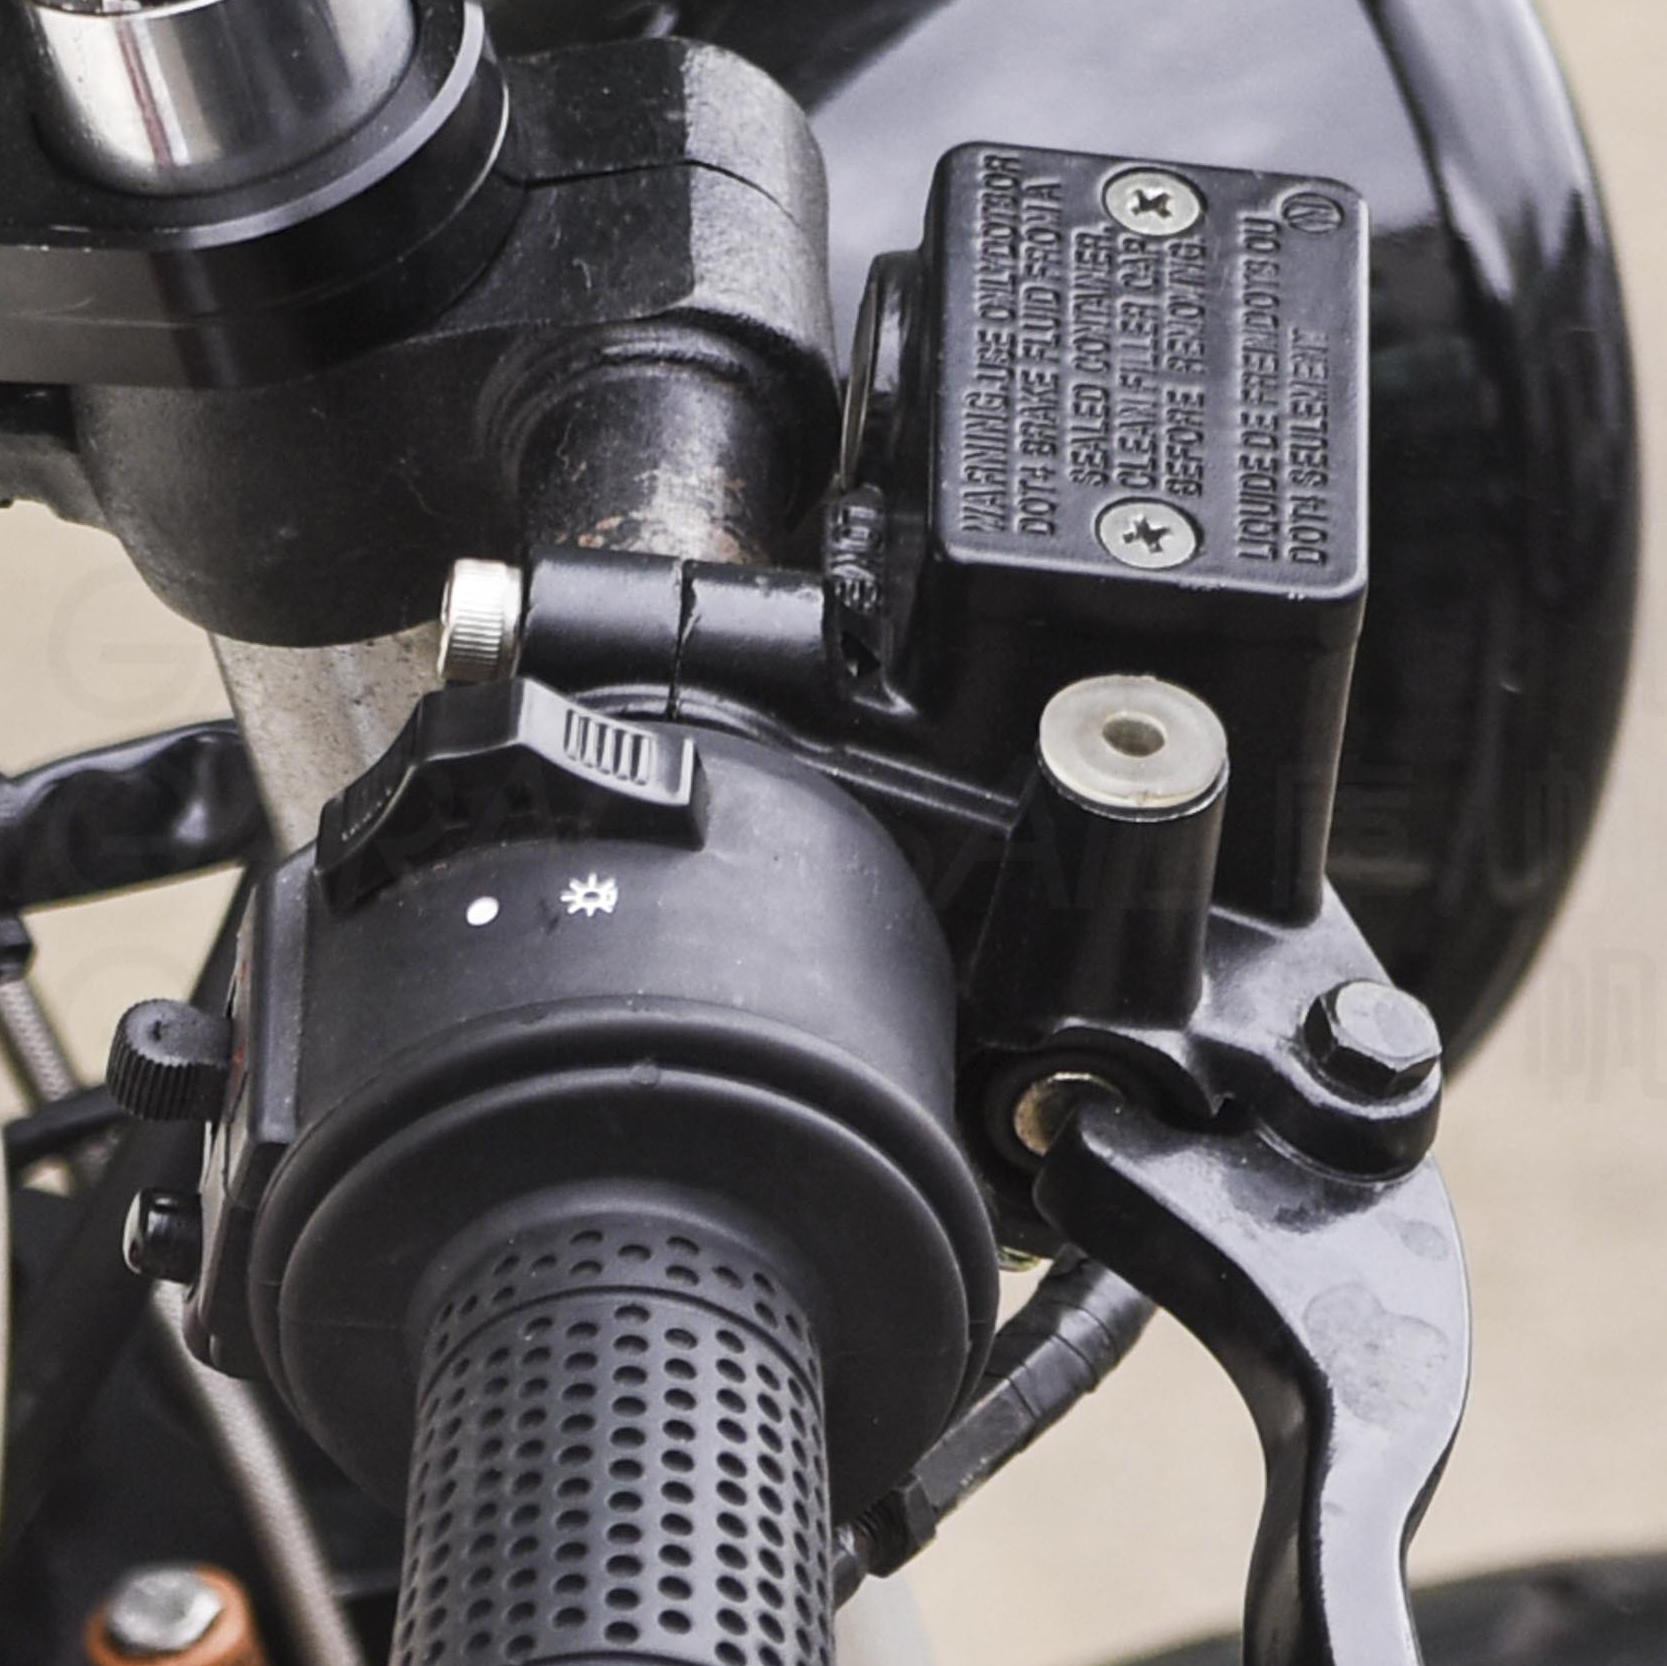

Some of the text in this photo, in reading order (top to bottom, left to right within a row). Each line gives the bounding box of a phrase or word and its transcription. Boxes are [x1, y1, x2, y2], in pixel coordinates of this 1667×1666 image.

[1017, 282, 1061, 365] FLUID
[1113, 232, 1159, 489] CLEAN FILLER CAP
[1014, 366, 1058, 458] BRAKE
[1067, 380, 1109, 487] SEALED
[1162, 384, 1203, 496] BEFORE
[1235, 409, 1279, 451] DE
[1235, 451, 1279, 562] LIQUIDE
[1283, 493, 1328, 565] DOT4
